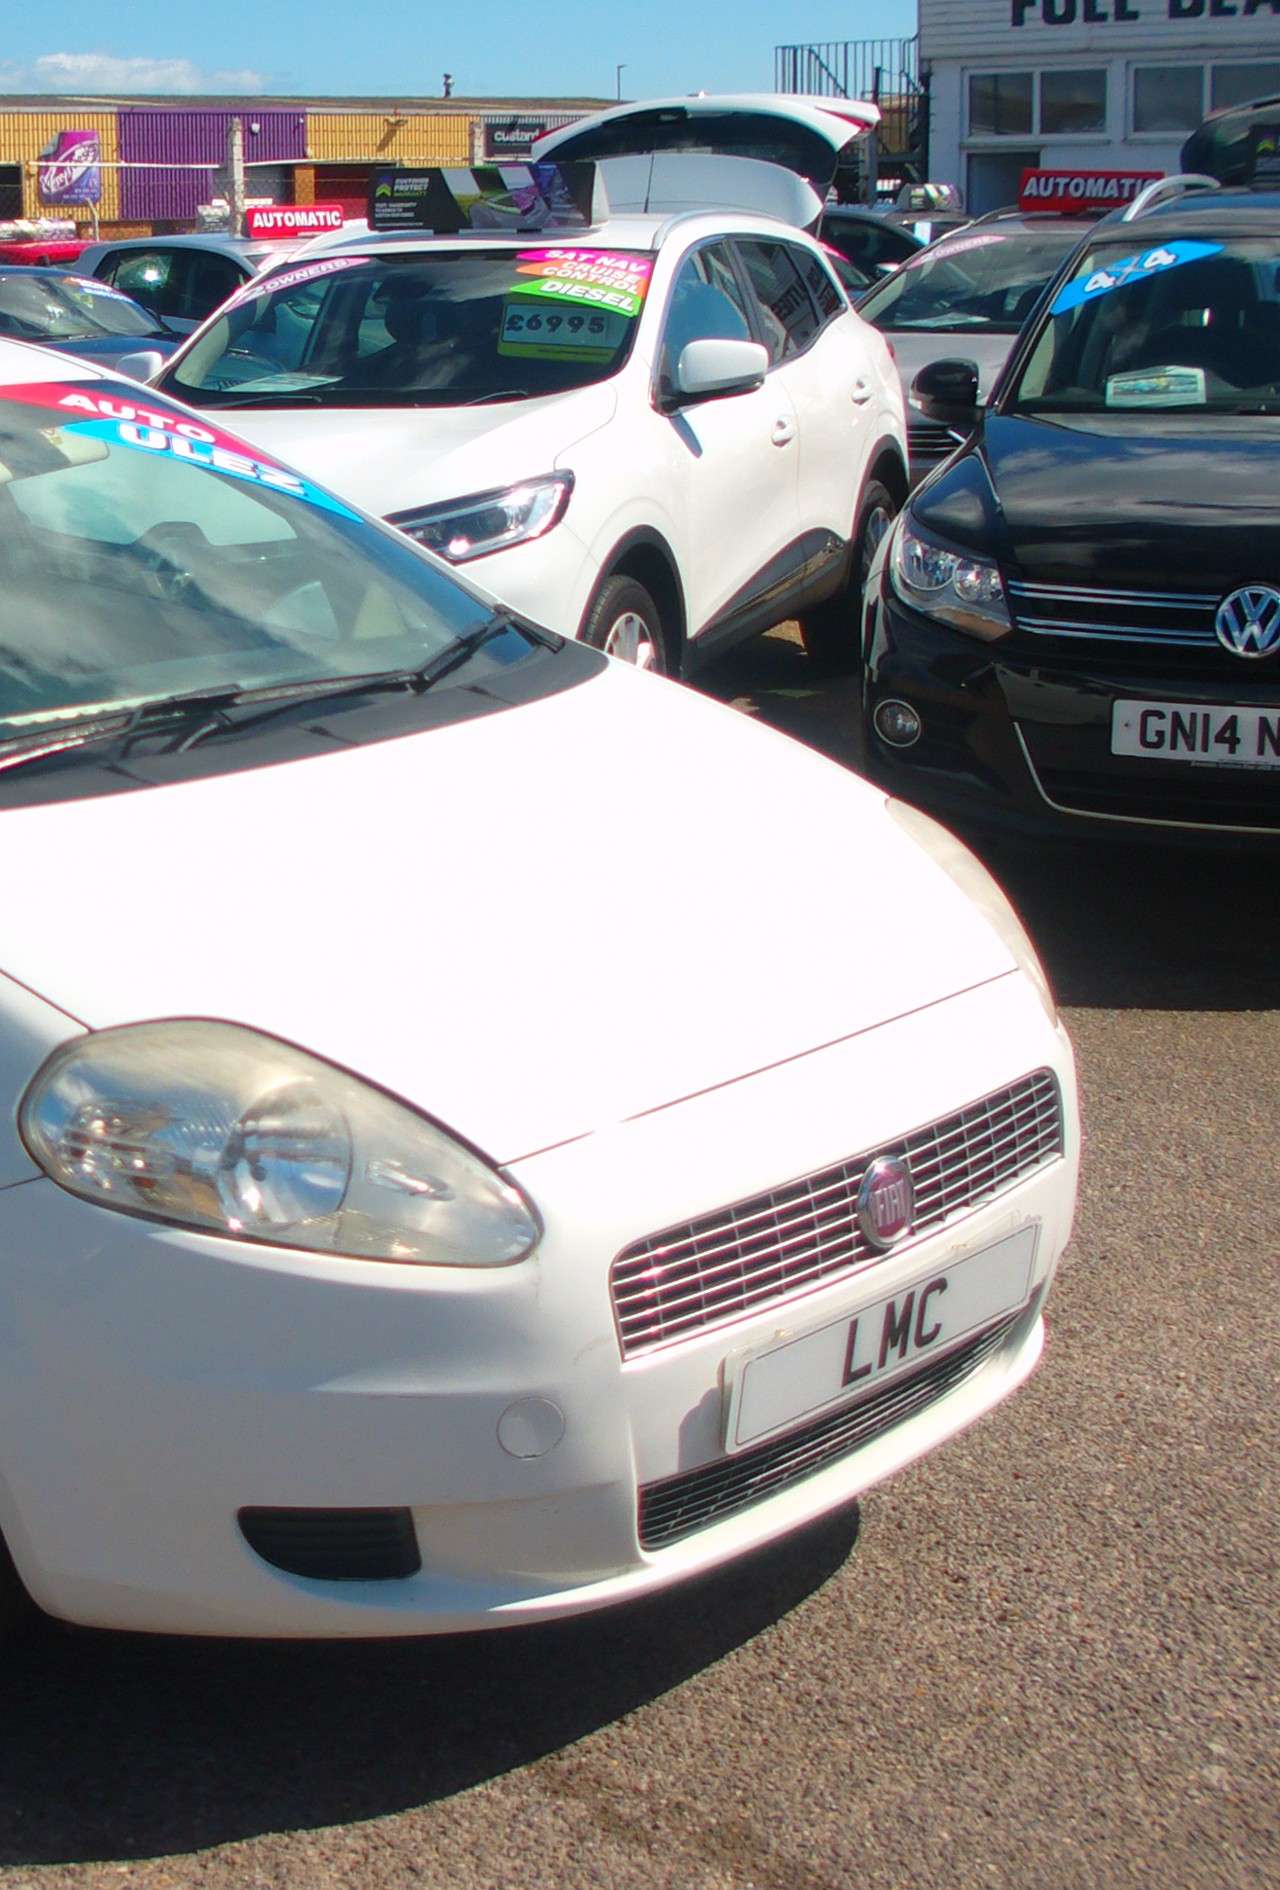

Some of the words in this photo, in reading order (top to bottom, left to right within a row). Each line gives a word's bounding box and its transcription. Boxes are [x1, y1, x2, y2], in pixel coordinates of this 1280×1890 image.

[253, 210, 341, 228] AUTOMATIC
[545, 250, 595, 261] SAT
[596, 256, 647, 273] NAV
[562, 261, 641, 284] CRUISE
[543, 266, 639, 295] CONTROL
[540, 280, 634, 312] DIESEL
[506, 314, 605, 334] £6995
[58, 393, 216, 443] AUTO
[119, 421, 308, 497] ULEZ
[841, 1277, 948, 1388] LMC
